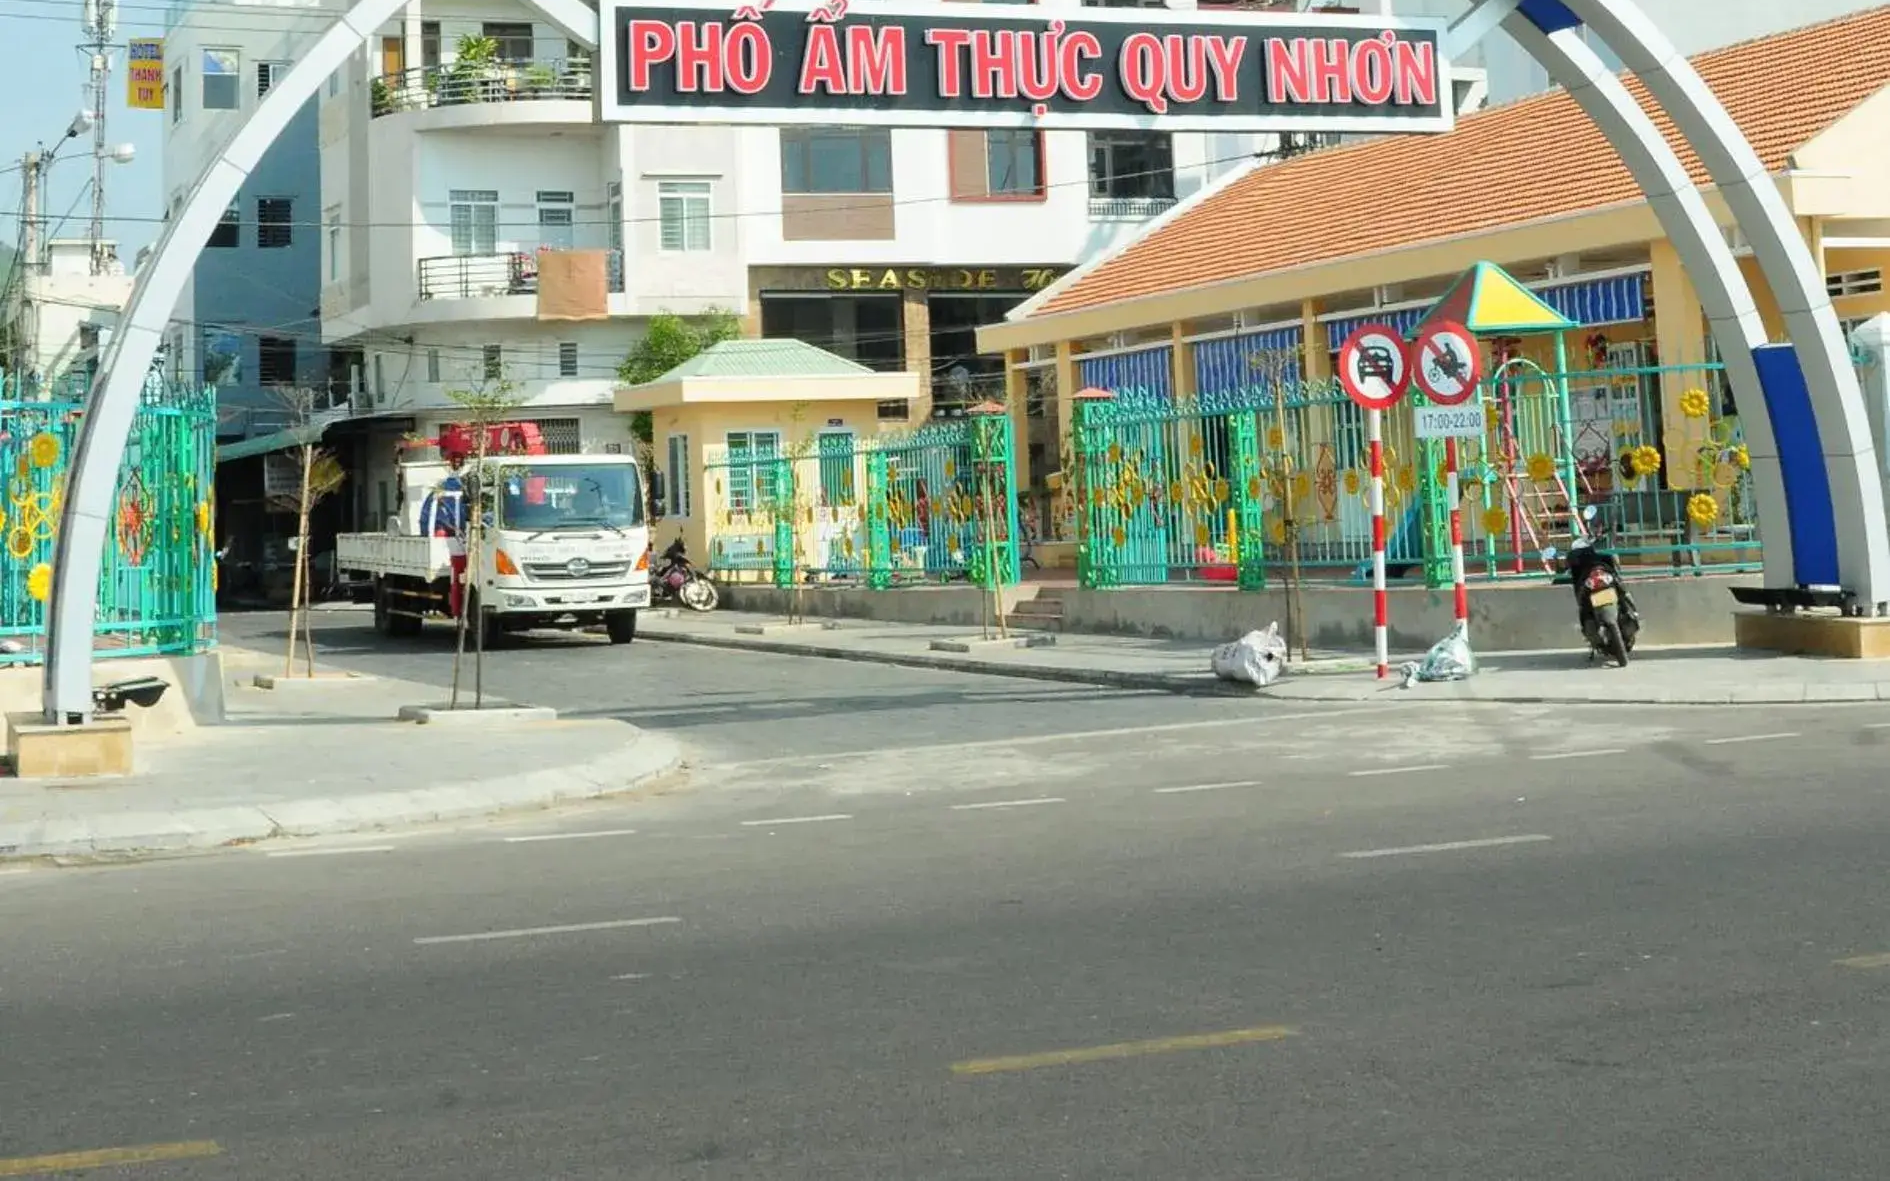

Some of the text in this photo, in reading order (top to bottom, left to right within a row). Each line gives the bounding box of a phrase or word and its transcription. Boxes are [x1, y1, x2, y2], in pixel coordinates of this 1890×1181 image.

[924, 19, 1102, 117] THỰC
[1120, 32, 1248, 115] QUY
[1266, 29, 1437, 105] NHƠN
[1422, 412, 1481, 429] 17:00-22:00
